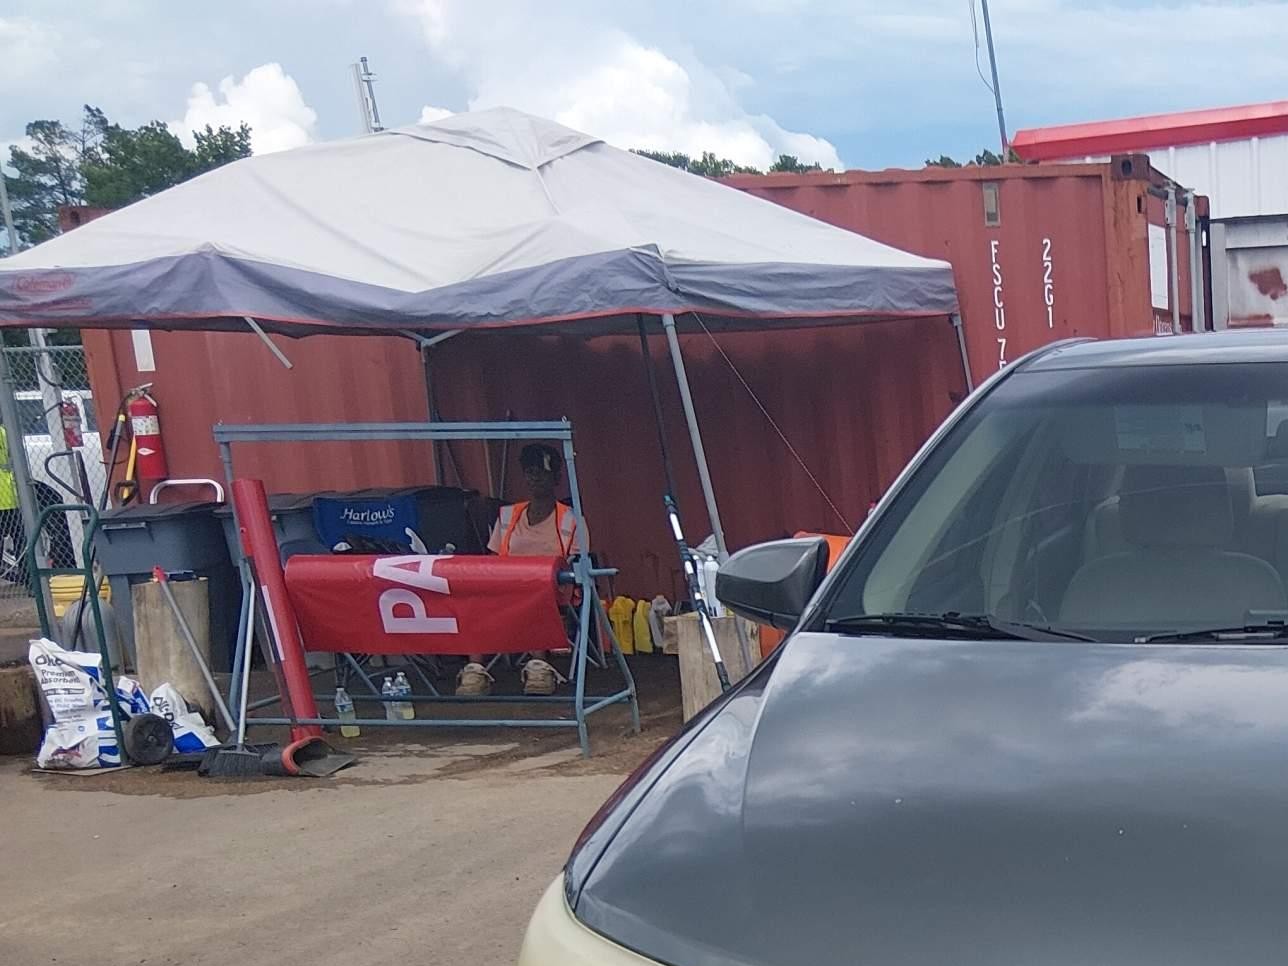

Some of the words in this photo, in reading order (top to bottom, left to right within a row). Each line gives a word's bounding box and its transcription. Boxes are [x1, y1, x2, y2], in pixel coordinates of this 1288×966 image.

[990, 239, 1005, 330] FSCU
[1042, 238, 1054, 328] 22G1
[340, 504, 395, 521] Harlow's
[41, 668, 76, 678] Premium
